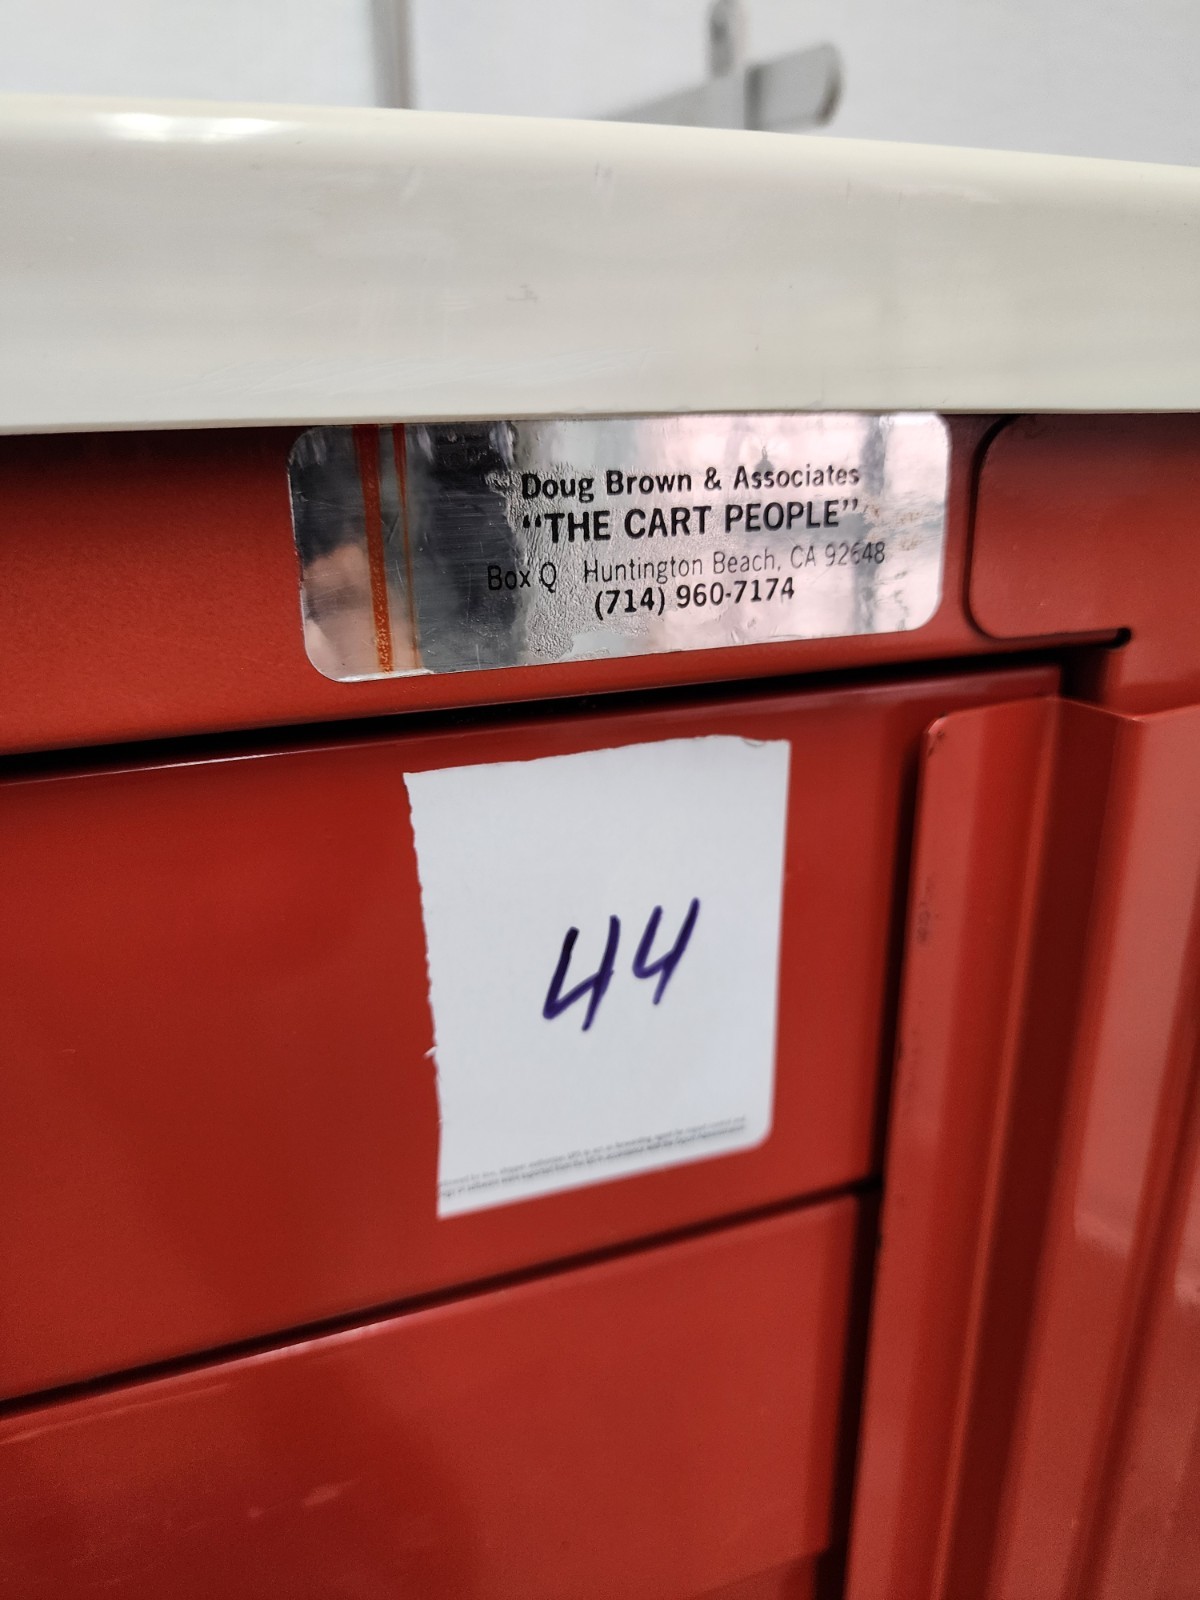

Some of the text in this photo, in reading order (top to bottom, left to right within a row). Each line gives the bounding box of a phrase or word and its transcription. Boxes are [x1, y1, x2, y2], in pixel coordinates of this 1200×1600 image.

[521, 464, 860, 503] Doug Brown & Associates
[522, 499, 859, 543] “THE CART PEOPLE”
[487, 541, 886, 593] Box Q Huntington Beach, CA 92648
[595, 577, 795, 621] (714) 960-7174
[542, 897, 700, 1032] 44
